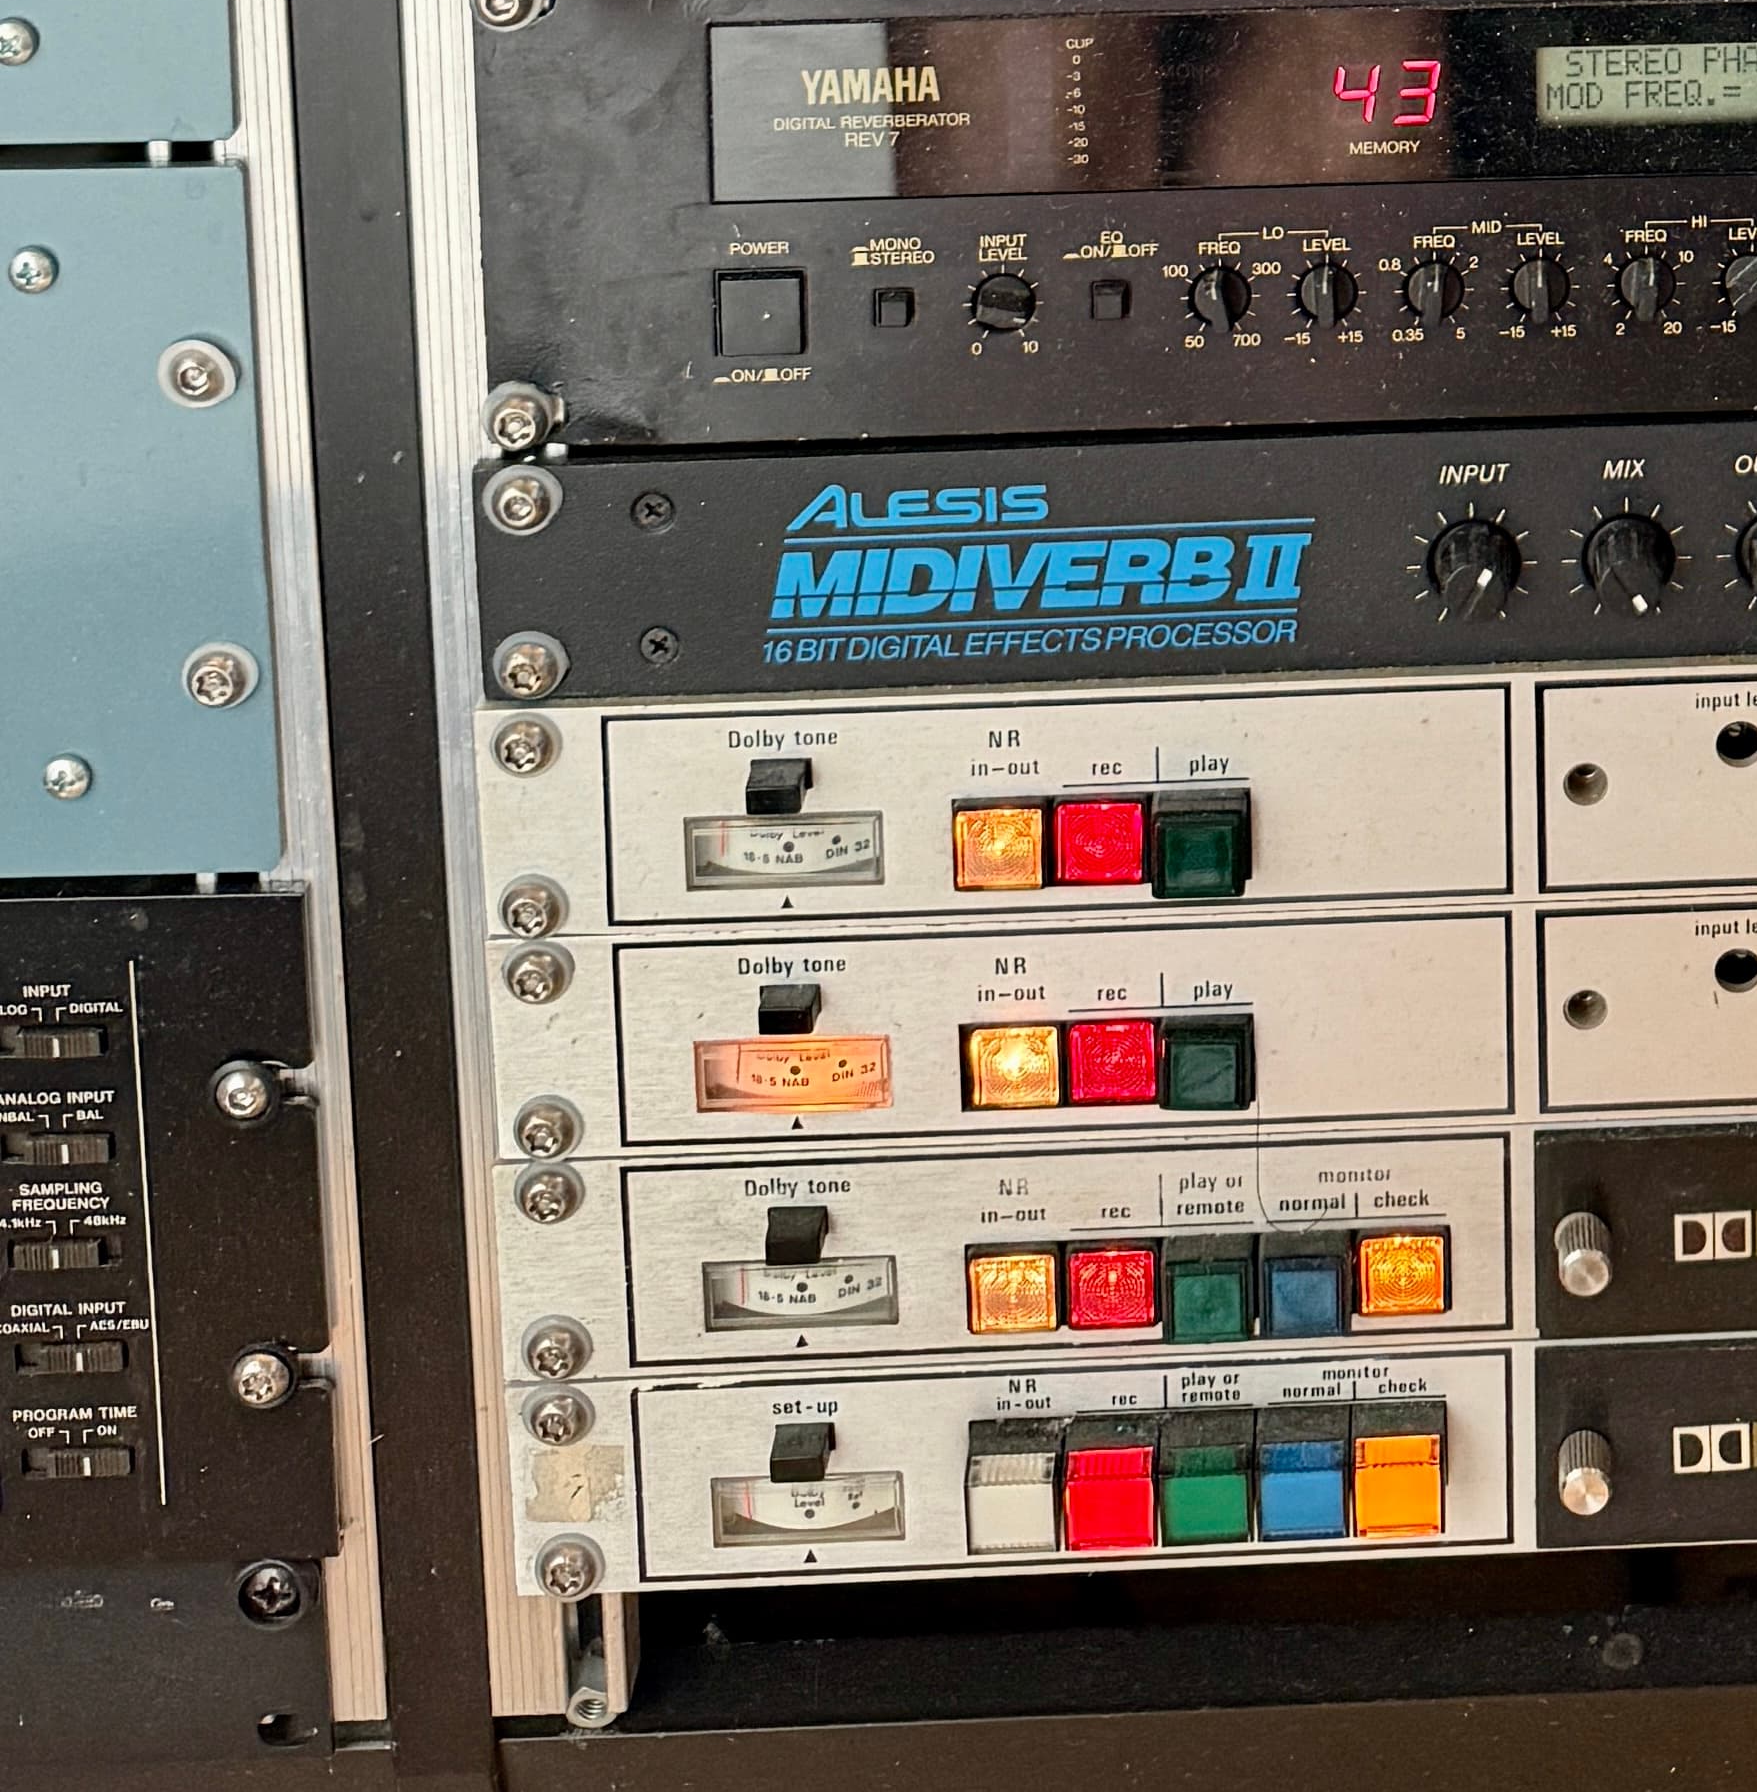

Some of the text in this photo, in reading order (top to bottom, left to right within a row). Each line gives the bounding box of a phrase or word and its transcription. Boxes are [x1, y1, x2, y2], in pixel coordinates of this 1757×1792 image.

[1566, 48, 1681, 77] STEREO
[800, 67, 939, 105] YAMAHA
[1334, 60, 1441, 126] 43
[1546, 83, 1603, 111] MOD
[773, 113, 970, 132] DIGITAL REVERBERATOR
[845, 131, 900, 148] REV 7
[1349, 141, 1420, 155] MEMORY
[787, 484, 1047, 530] ALESIS
[771, 533, 1311, 619] MIDIVERB II
[763, 620, 1297, 662] 16 BIT DIGITAL EFFECTS PROCESSOR
[728, 728, 838, 750] Dolby tone
[13, 1404, 137, 1421] PROGRAM TIME
